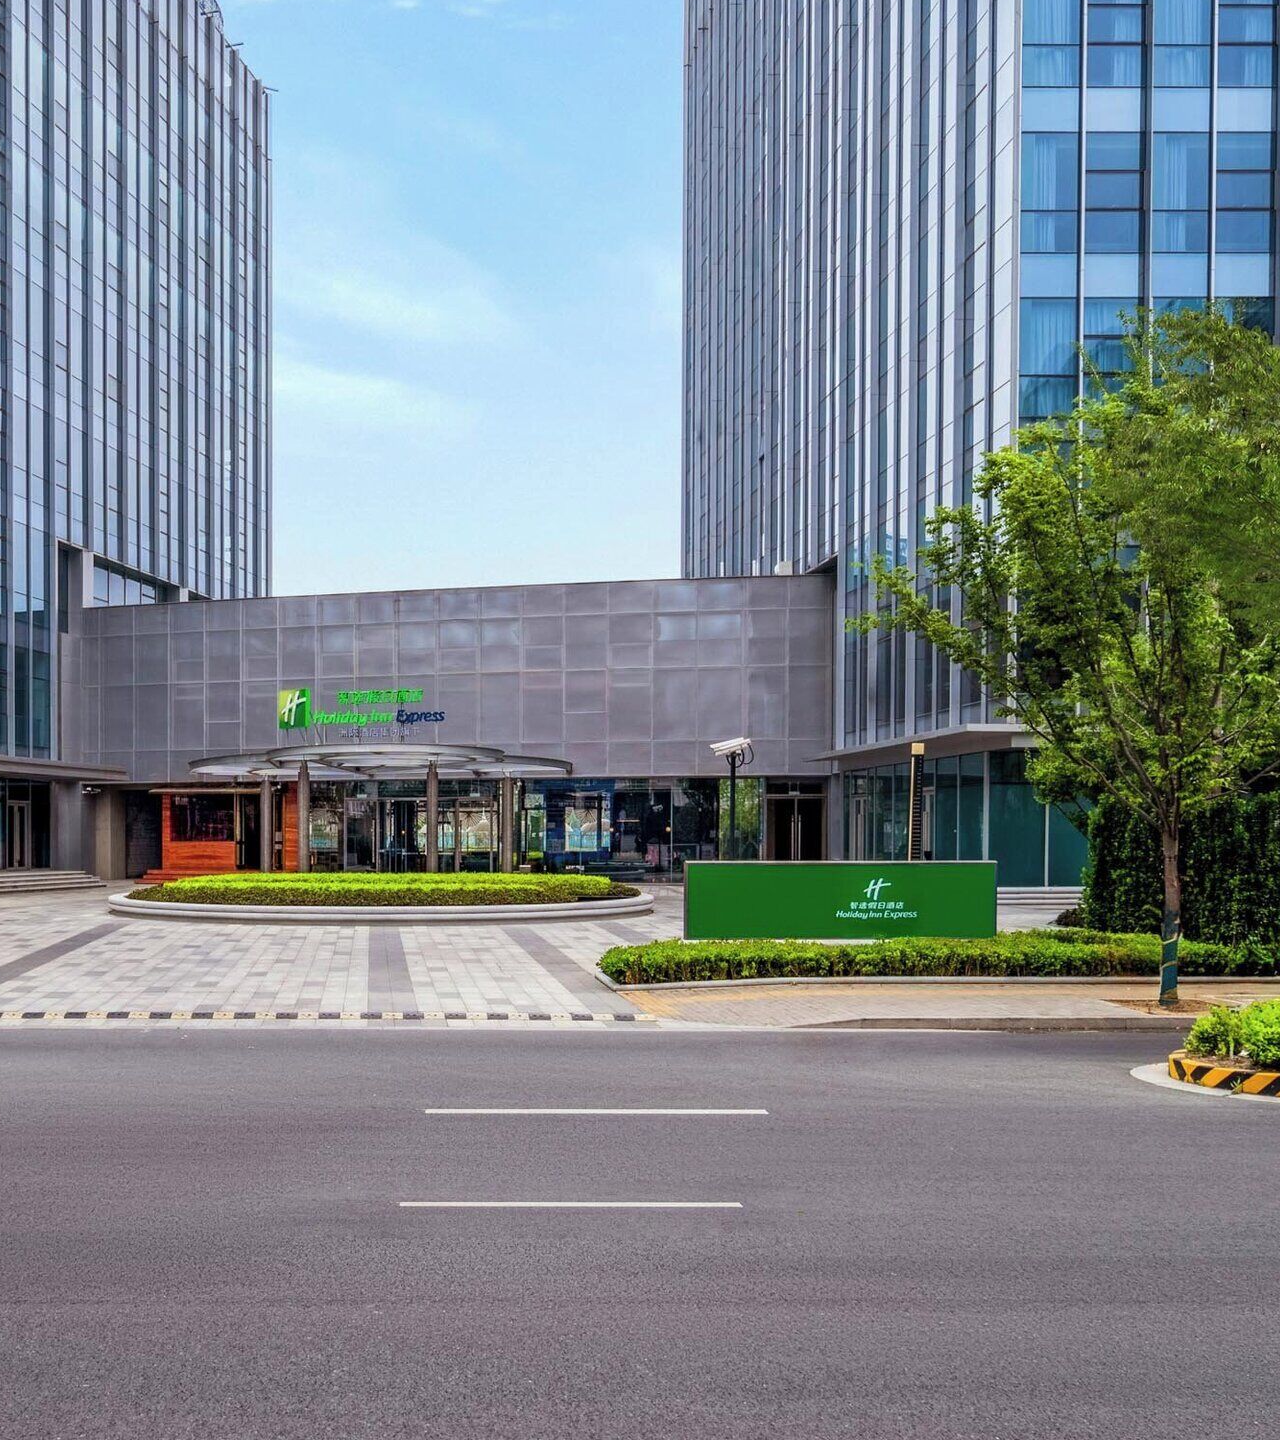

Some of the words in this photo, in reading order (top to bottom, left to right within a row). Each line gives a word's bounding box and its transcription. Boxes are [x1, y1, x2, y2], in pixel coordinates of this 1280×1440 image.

[313, 710, 368, 727] Holiday
[396, 709, 445, 726] Express
[836, 910, 868, 920] Holiday
[869, 910, 882, 918] Inn
[883, 909, 918, 920] Express
